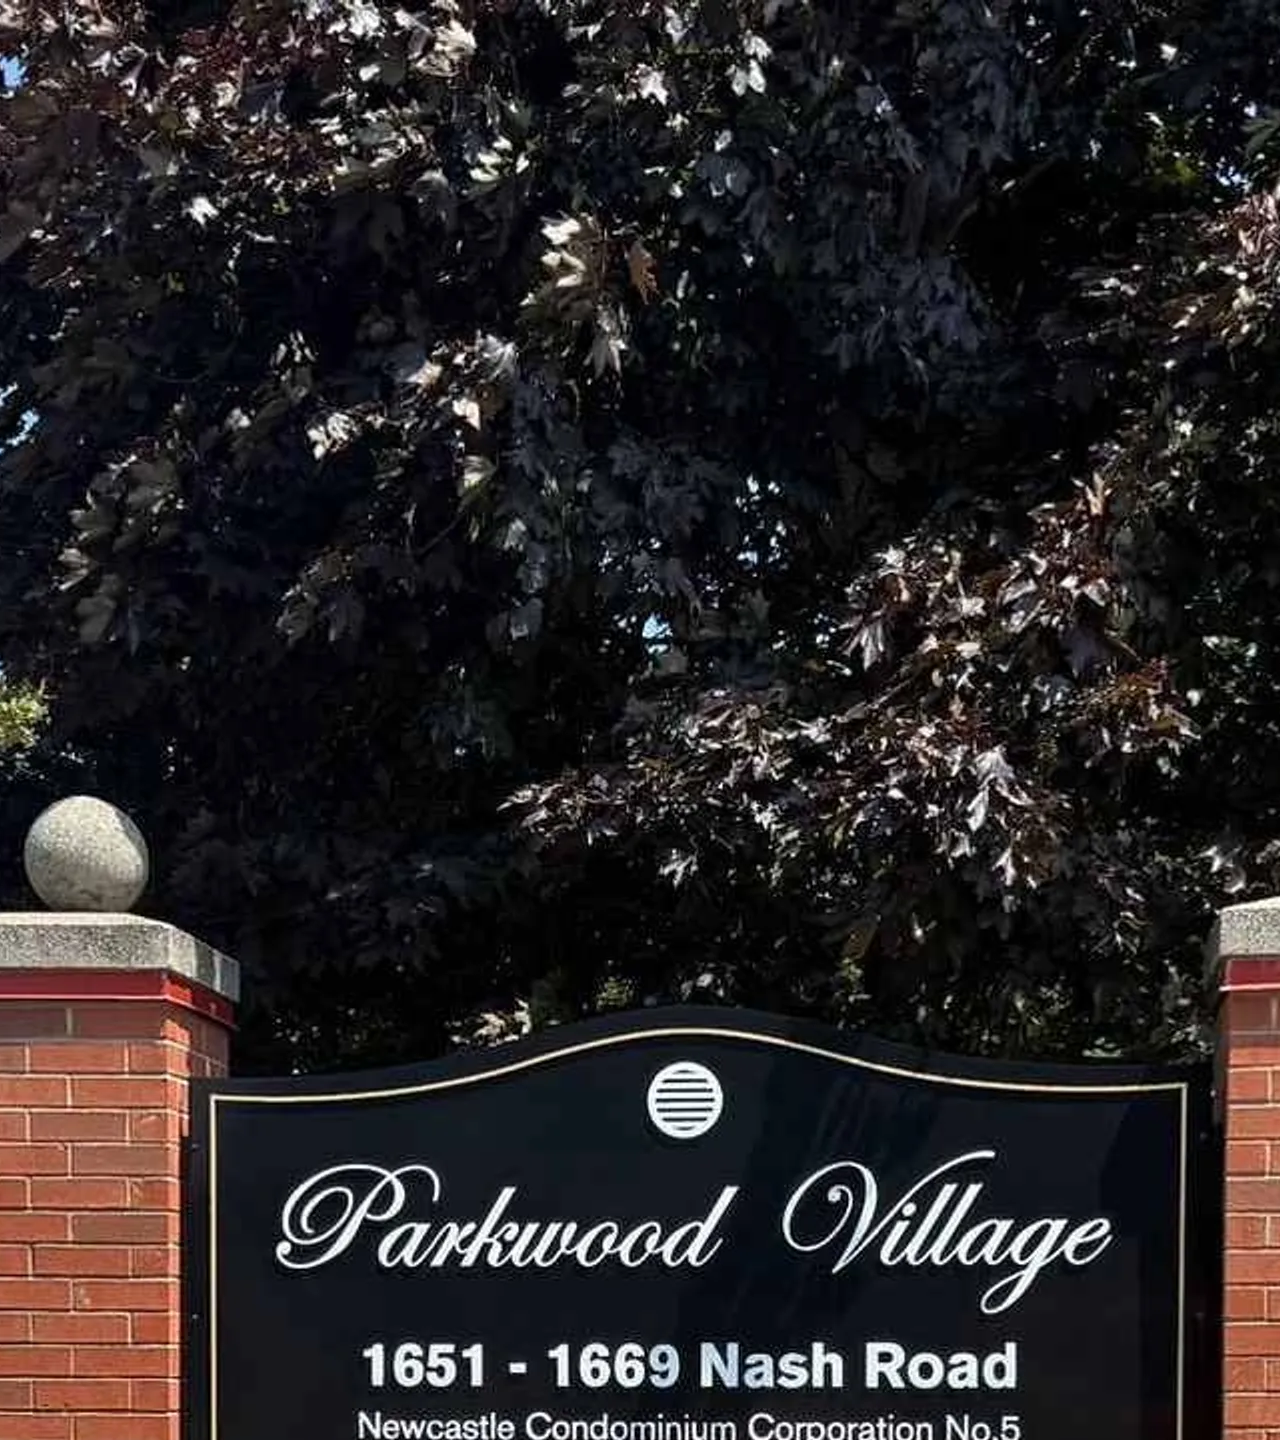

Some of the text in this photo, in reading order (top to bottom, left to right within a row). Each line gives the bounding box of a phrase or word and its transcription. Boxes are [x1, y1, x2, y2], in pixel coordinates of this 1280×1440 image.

[276, 1150, 1113, 1314] Parkwood Village
[362, 1341, 1017, 1390] 1651 - 1669 Nash Road
[358, 1410, 516, 1440] Newcastle
